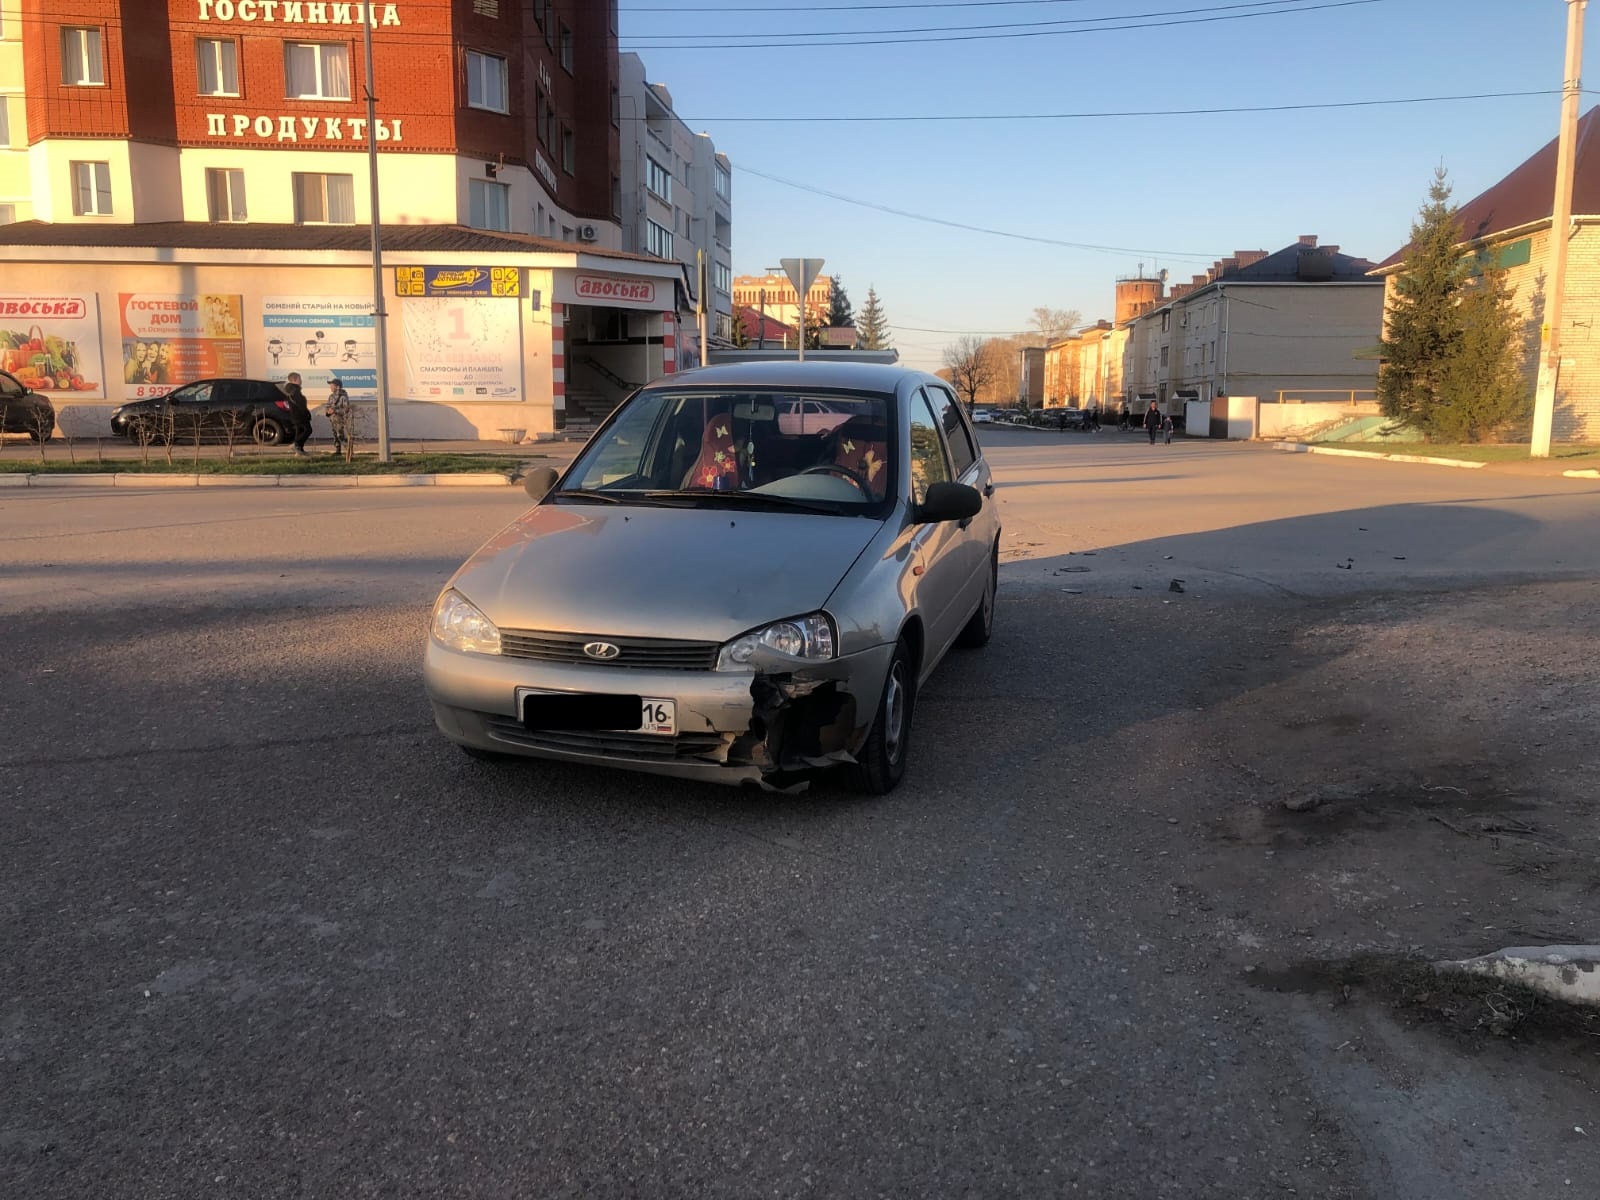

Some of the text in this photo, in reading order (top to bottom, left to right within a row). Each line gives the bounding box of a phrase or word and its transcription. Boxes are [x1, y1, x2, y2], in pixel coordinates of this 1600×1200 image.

[198, 0, 401, 28] ГОСТИНИЦА
[206, 113, 402, 142] ПРОДУКТЫ
[131, 299, 199, 311] ГОСТЕВОЙ
[266, 302, 301, 310] ОБМЕНЯЙ
[302, 302, 332, 310] СТАРЫЙ
[150, 313, 182, 325] ДОМ
[447, 308, 471, 340] 1
[136, 386, 145, 397] 8
[642, 703, 667, 723] 16
